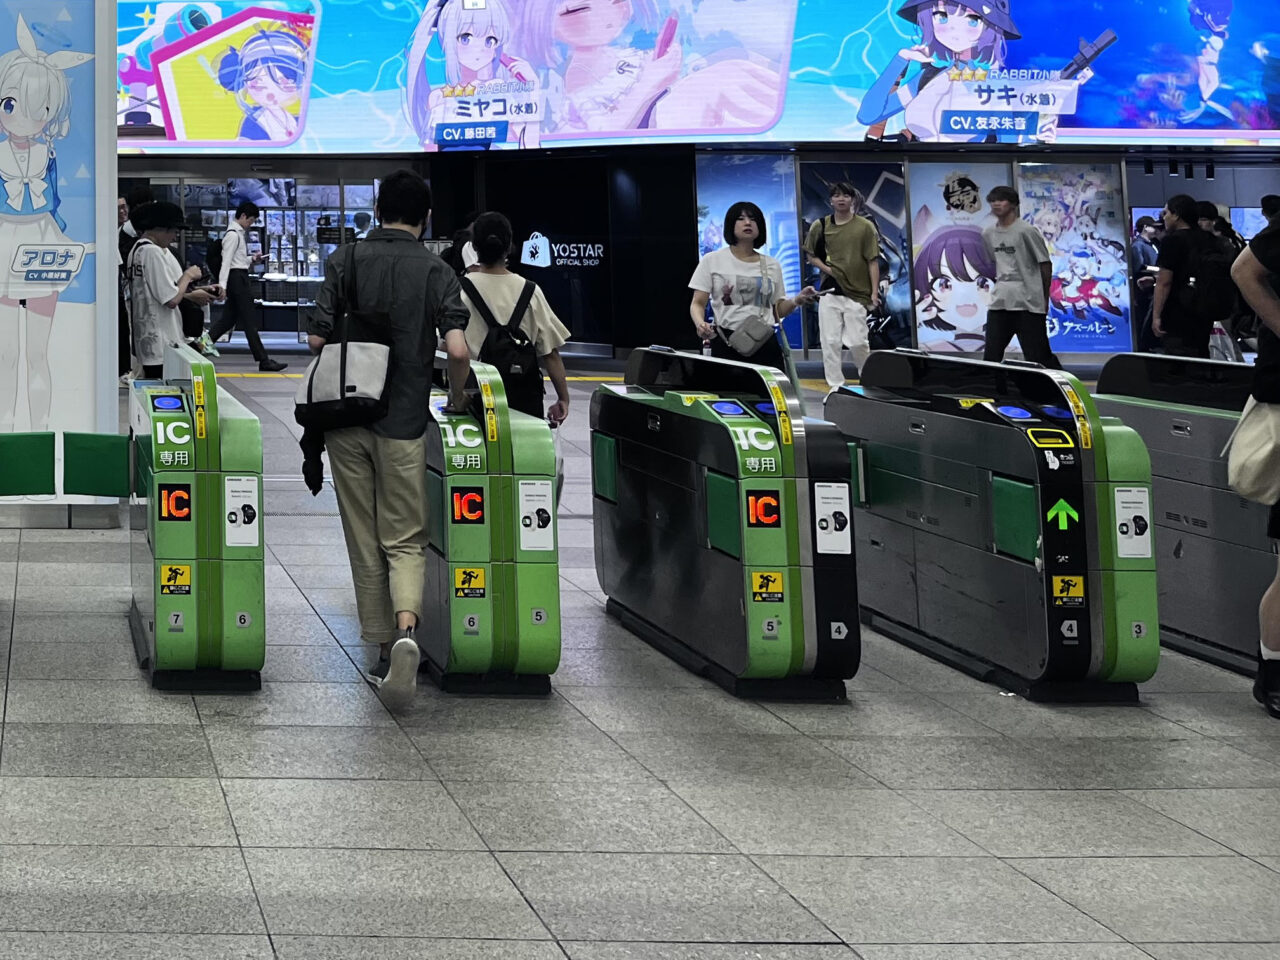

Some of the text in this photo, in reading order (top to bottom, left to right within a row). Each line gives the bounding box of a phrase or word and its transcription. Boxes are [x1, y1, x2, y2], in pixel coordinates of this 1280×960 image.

[551, 243, 604, 257] YOSTAR
[21, 249, 76, 268] アロナ
[556, 258, 600, 267] OFFICIAL SHOP
[156, 421, 191, 444] IC
[441, 424, 482, 448] IC
[733, 427, 775, 451] IC
[159, 450, 189, 466] 専用
[451, 454, 481, 469] 専用
[745, 457, 776, 472] 専用
[161, 489, 189, 518] IC
[453, 492, 483, 520] IC
[748, 495, 778, 524] IC
[173, 614, 180, 624] 7
[239, 614, 246, 624] 6
[467, 616, 475, 628] 6
[535, 610, 542, 622] 5
[766, 620, 774, 632] 5
[834, 625, 841, 636] 4
[1066, 623, 1073, 634] 4
[1134, 623, 1142, 635] 3
